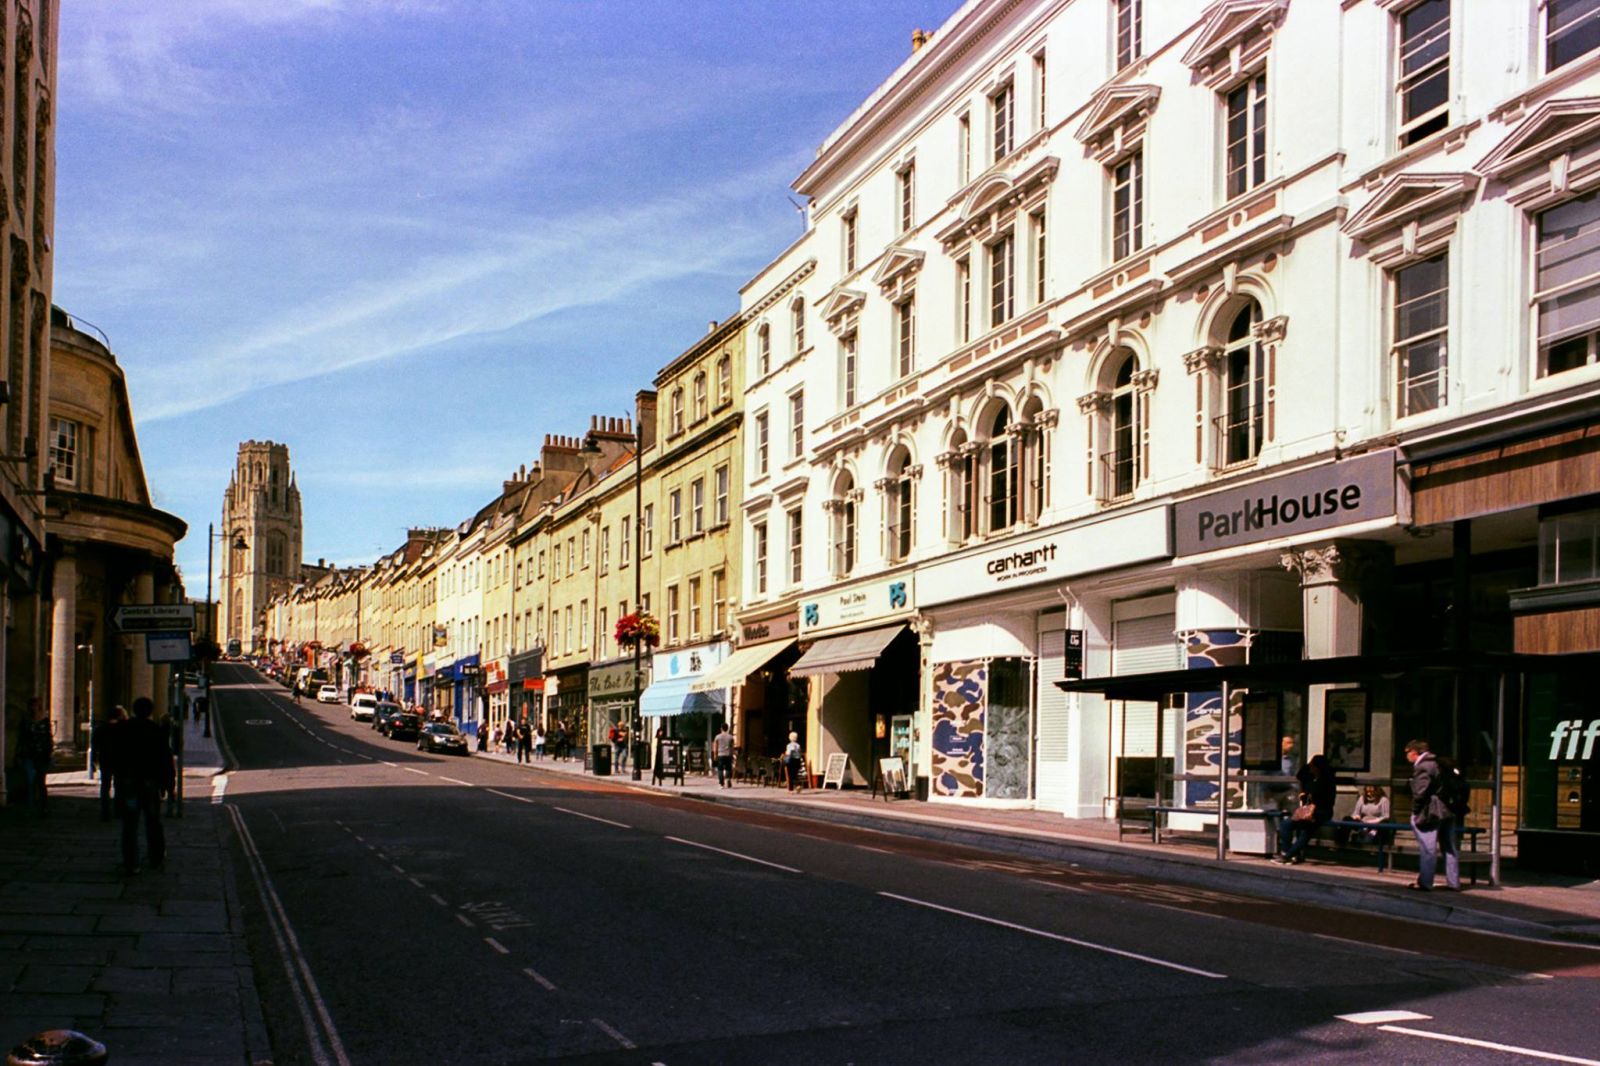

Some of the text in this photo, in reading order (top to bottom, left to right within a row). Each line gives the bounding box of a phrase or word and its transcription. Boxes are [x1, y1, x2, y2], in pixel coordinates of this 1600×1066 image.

[1198, 483, 1361, 541] ParkHouse
[987, 543, 1057, 574] carhartt
[889, 582, 906, 609] PS
[122, 607, 180, 616] Central Library
